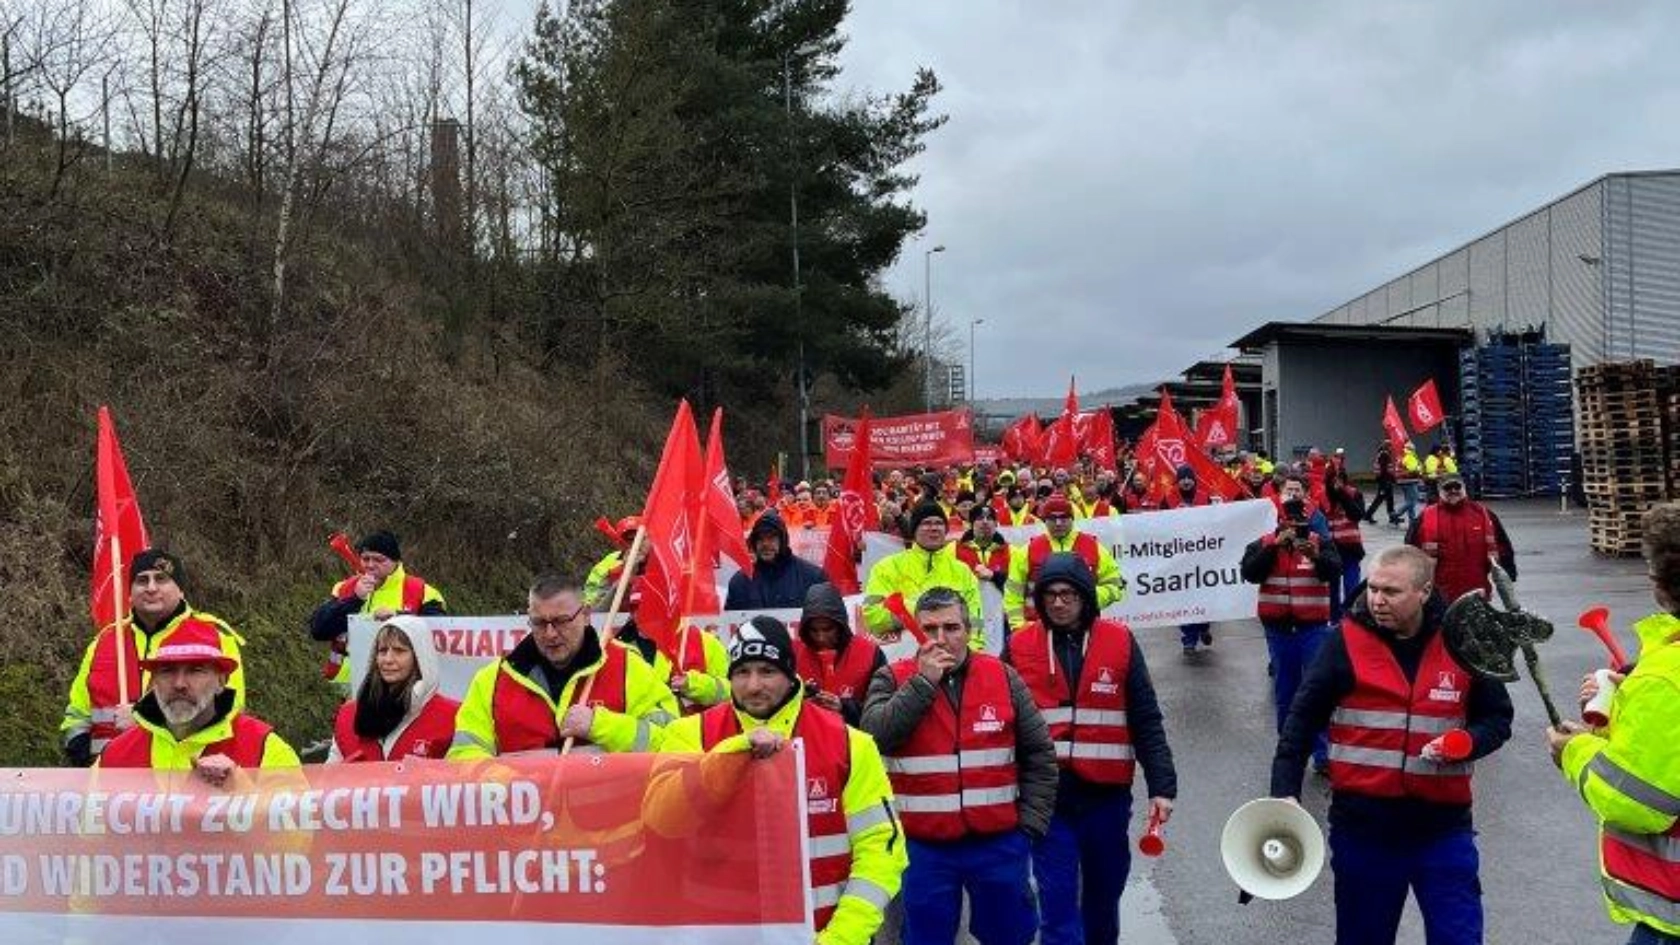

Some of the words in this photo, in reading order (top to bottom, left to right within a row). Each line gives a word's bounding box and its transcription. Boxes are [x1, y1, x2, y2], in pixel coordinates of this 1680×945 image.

[0, 790, 195, 835] UNRECHT
[201, 793, 259, 833] ZU
[269, 785, 409, 831] RECHT
[421, 780, 555, 832] WIRD,
[39, 852, 311, 896] WIDERSTAND
[325, 852, 410, 896] ZUR
[421, 849, 605, 894] PFLICHT:
